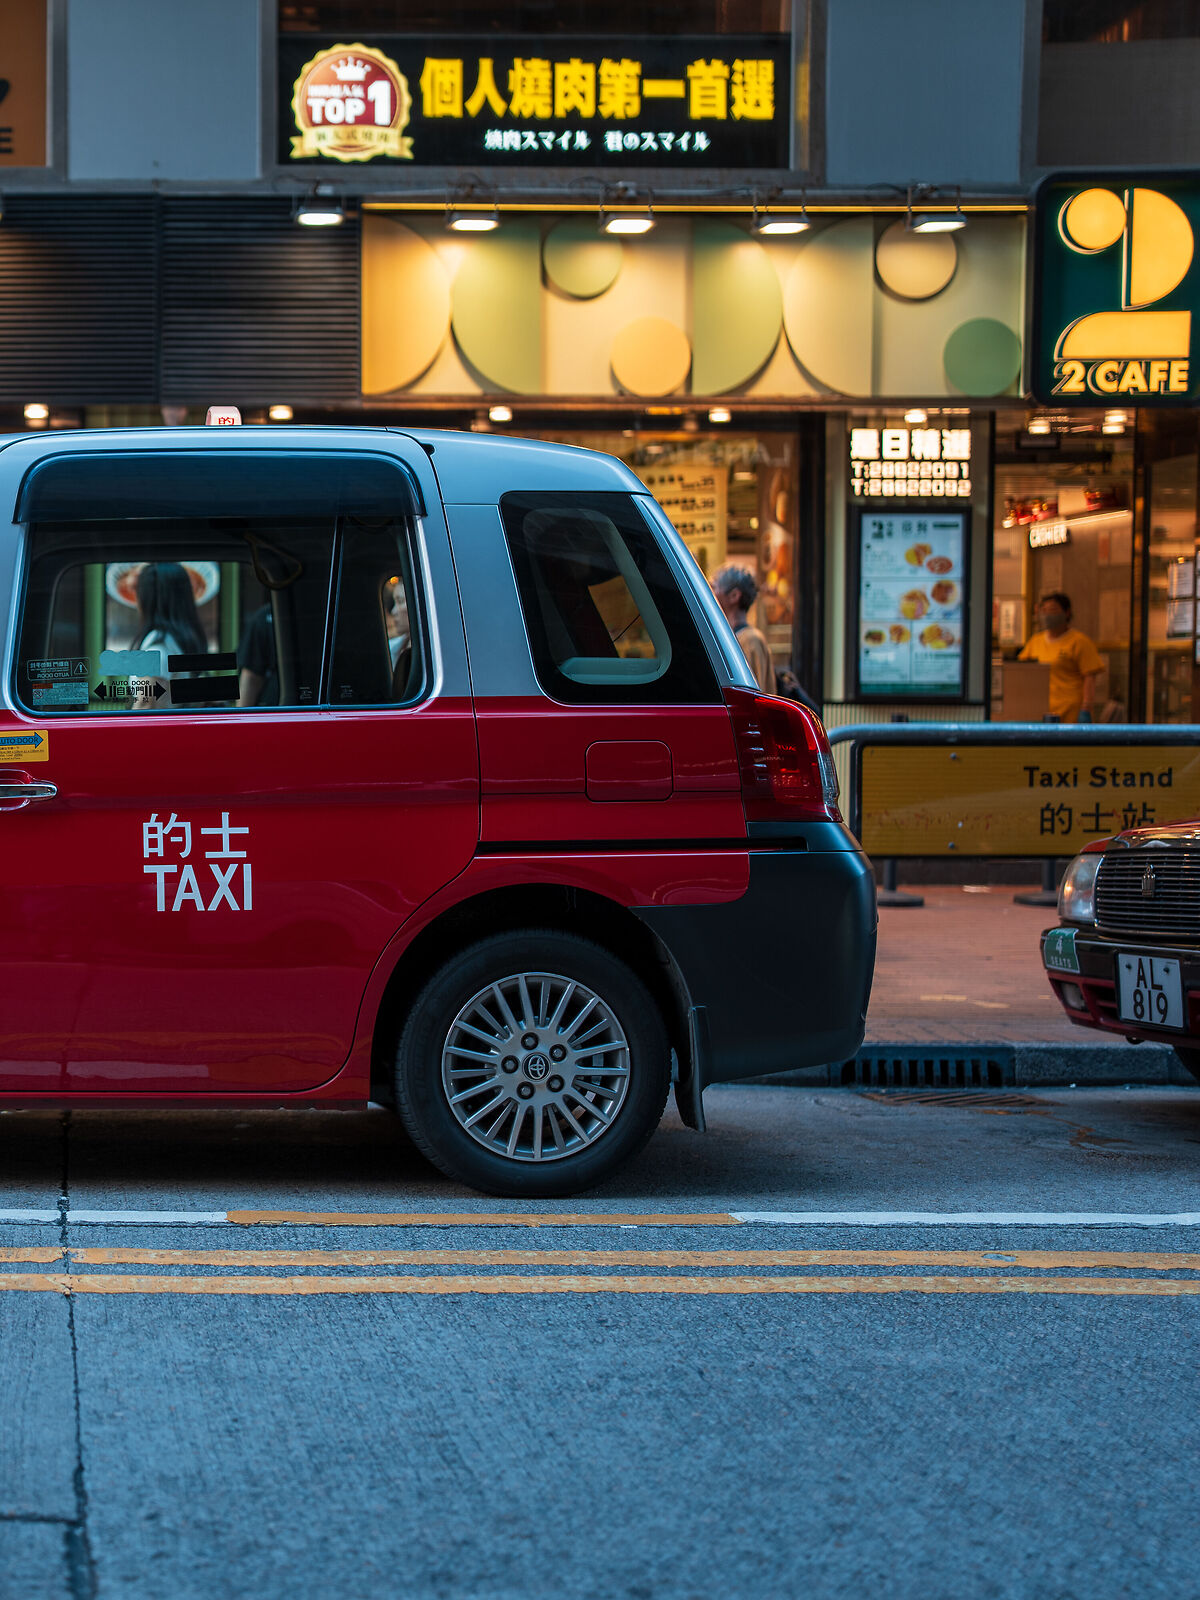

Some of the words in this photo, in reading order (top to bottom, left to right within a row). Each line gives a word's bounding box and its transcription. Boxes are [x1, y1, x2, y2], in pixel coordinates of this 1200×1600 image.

[307, 98, 366, 124] TOP
[367, 80, 391, 126] 1
[420, 57, 775, 121] 個人燒肉第一首選
[1092, 360, 1190, 394] CAFE
[116, 686, 145, 696] 自動門
[1023, 766, 1078, 788] Taxi
[1089, 766, 1173, 788] Stand
[143, 812, 249, 859] 的士
[143, 863, 253, 912] TAXI
[1050, 955, 1072, 969] SEATS
[1055, 935, 1064, 955] 4
[1136, 957, 1163, 991] AL
[1133, 988, 1169, 1024] 819
